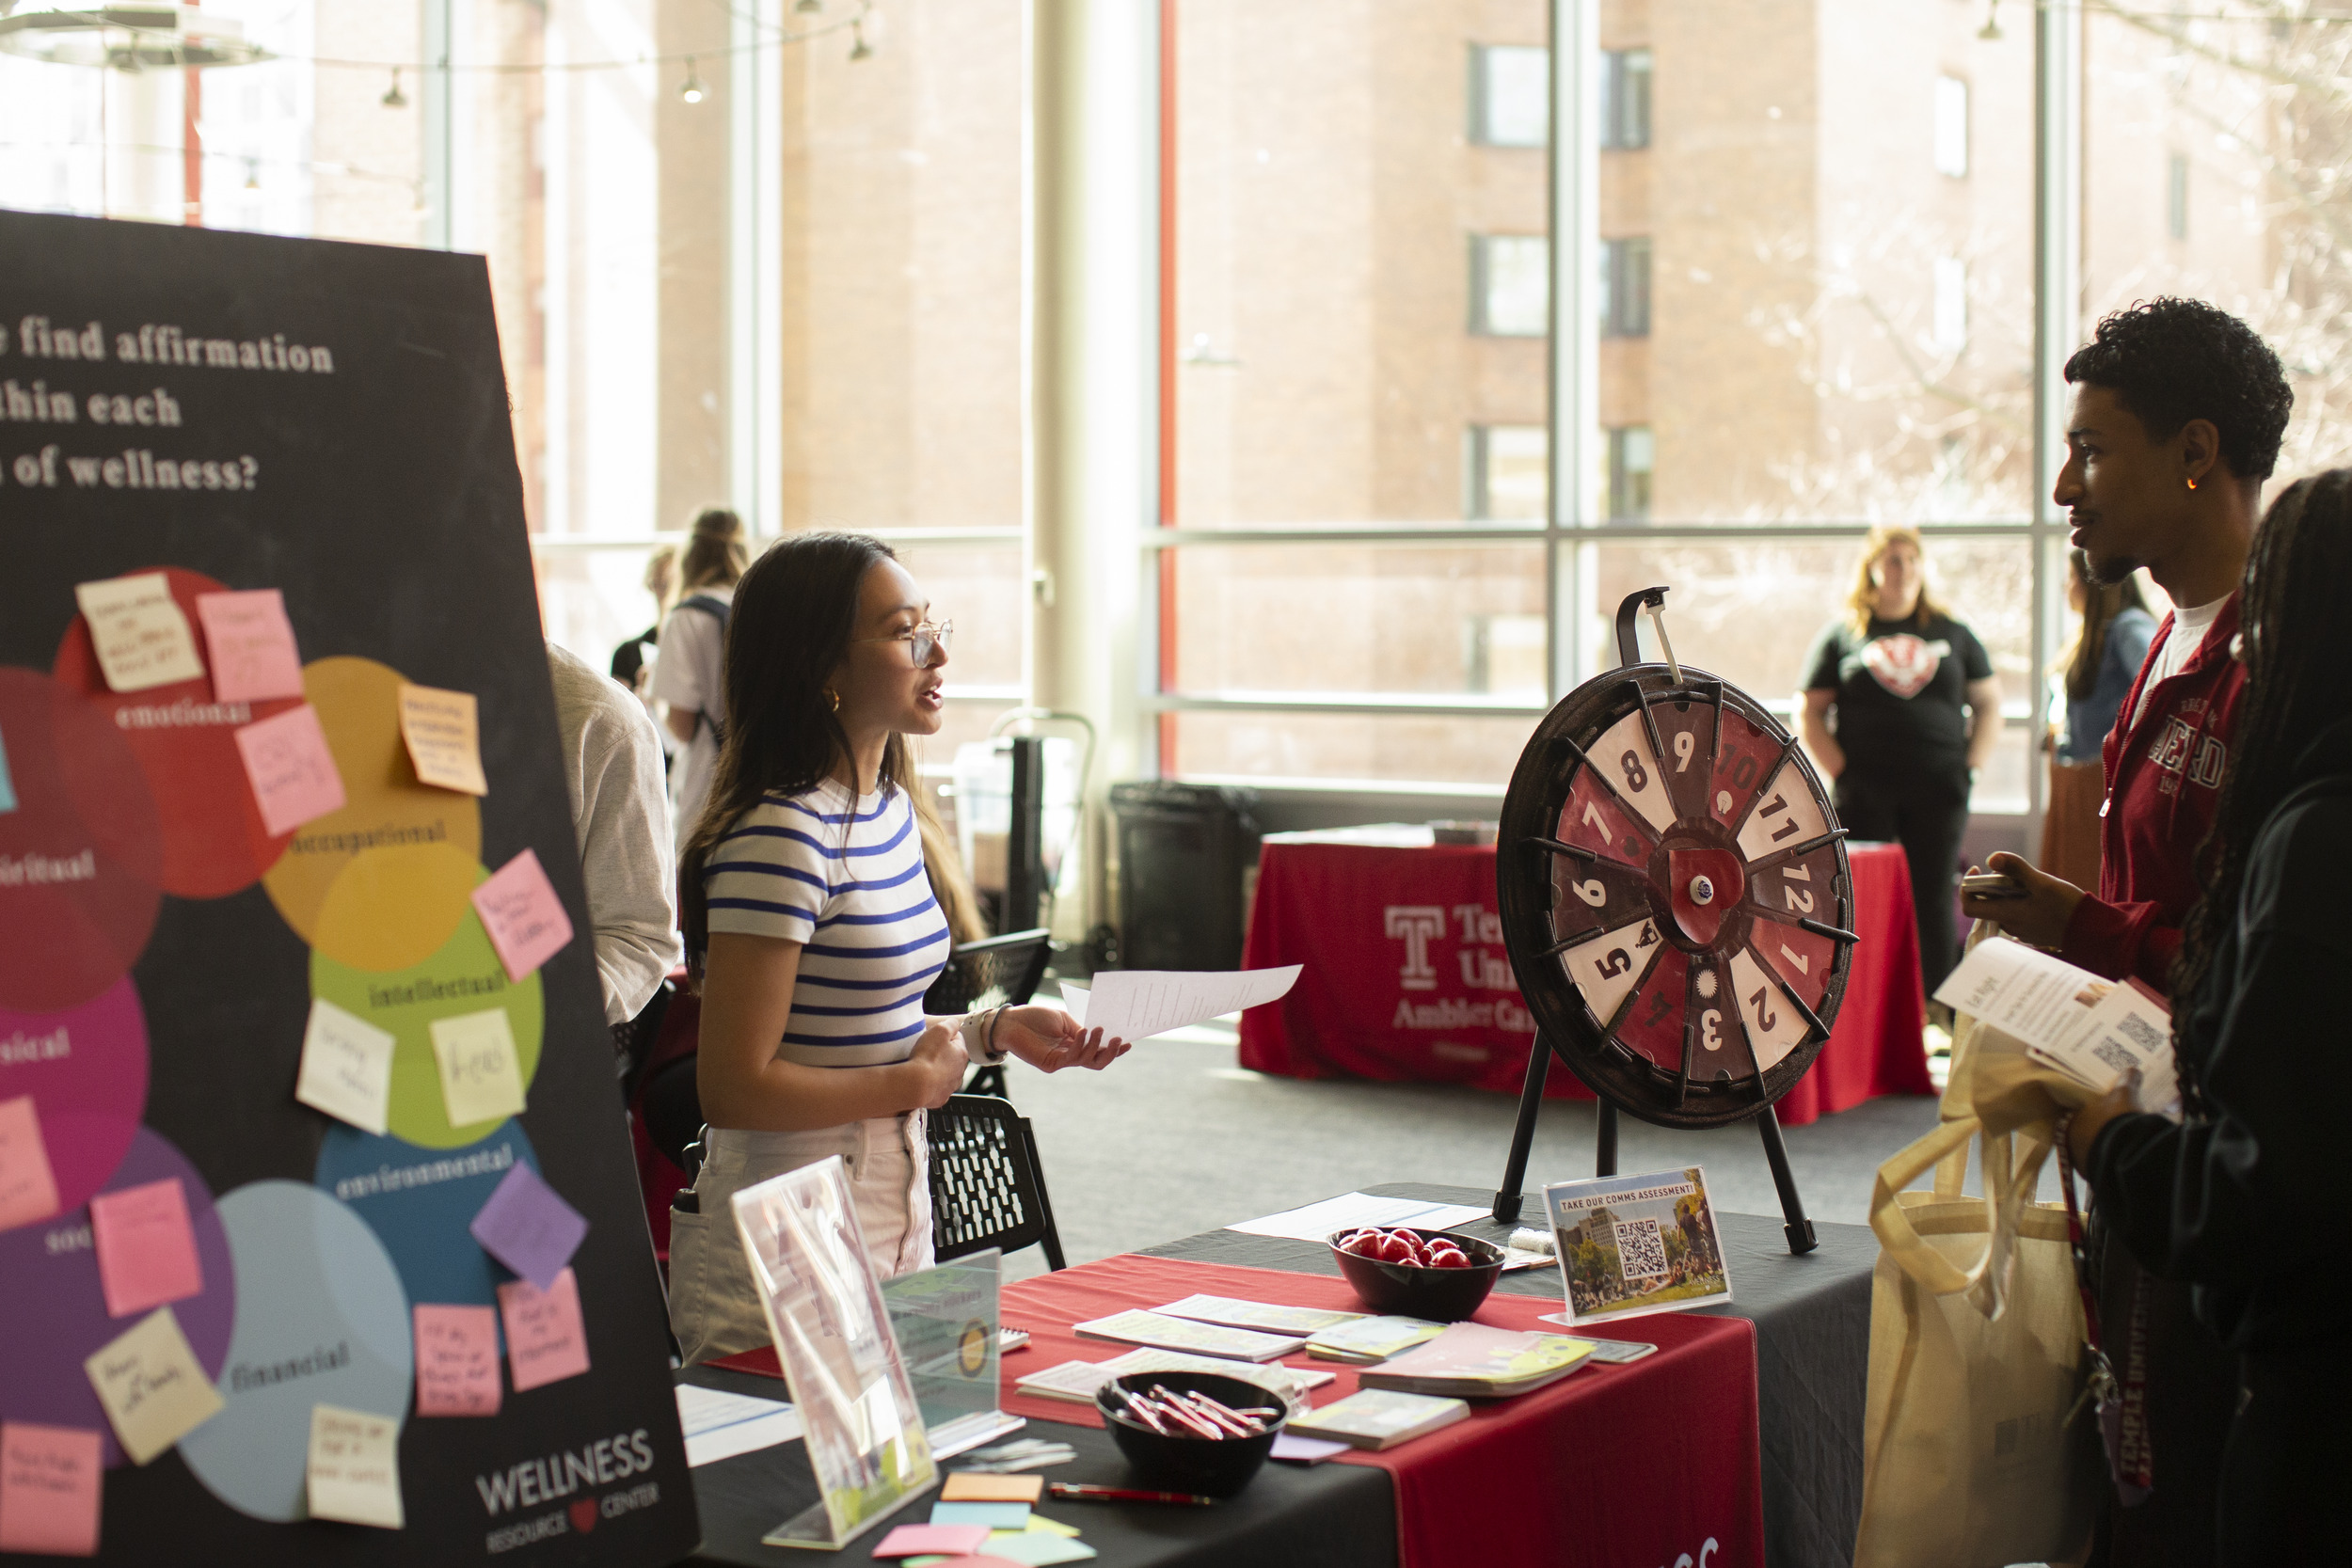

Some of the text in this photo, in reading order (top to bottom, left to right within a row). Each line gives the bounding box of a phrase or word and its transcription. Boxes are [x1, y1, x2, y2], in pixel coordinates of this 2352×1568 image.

[20, 316, 105, 361] find
[116, 325, 334, 373] affirmation
[87, 388, 182, 426] each
[14, 445, 259, 491] of wellness?
[116, 698, 251, 728] emotional
[1620, 749, 1648, 793] 8
[1674, 731, 1694, 773] 9
[1718, 742, 1757, 789] 10
[290, 819, 447, 857] occupational
[1581, 800, 1613, 846] 7
[1757, 792, 1801, 843] 11
[1572, 879, 1607, 908] 6
[1782, 863, 1814, 913] 12
[1453, 903, 1505, 944] Te
[1595, 948, 1631, 979] 5
[1780, 942, 1809, 975] 1
[370, 971, 504, 1007] intellectual
[1644, 991, 1673, 1027] 4
[1748, 986, 1776, 1033] 2
[1701, 1008, 1722, 1051] 3
[336, 1143, 514, 1200] environmental
[1562, 1184, 1693, 1211] TAKE OUR COMMS ASSESSMENT!
[45, 1226, 92, 1255] soc
[230, 1339, 350, 1394] financial
[475, 1428, 654, 1517] WELLNESS
[485, 1481, 660, 1555] RESOURCE CENTER
